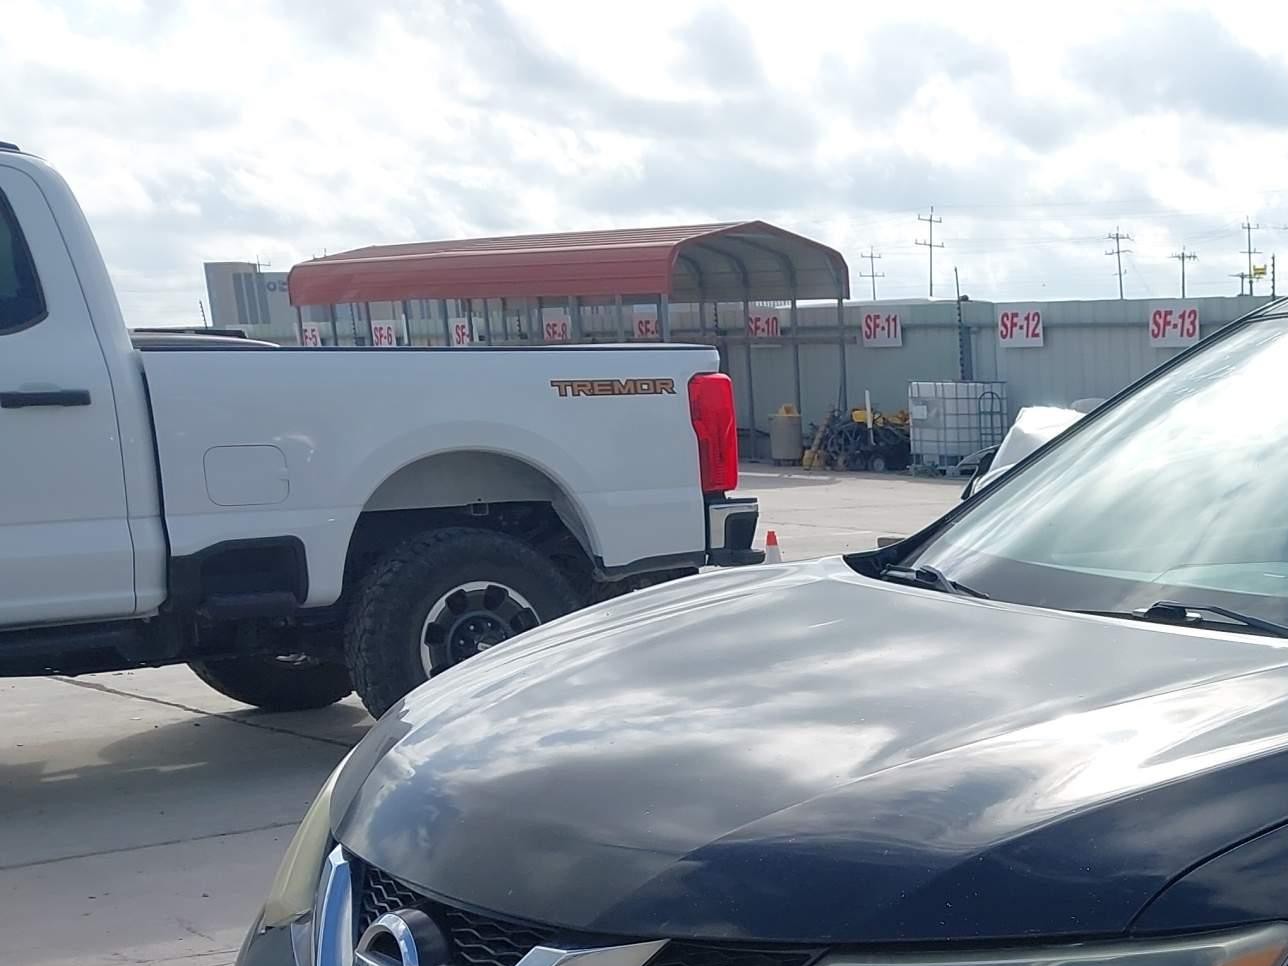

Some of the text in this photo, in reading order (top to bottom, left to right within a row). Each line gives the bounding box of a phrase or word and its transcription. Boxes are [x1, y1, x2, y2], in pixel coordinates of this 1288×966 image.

[863, 313, 899, 340] SF-11
[999, 311, 1041, 340] SF-12
[1150, 308, 1198, 339] SF-13
[303, 328, 318, 346] F-5
[373, 326, 394, 346] SF-6
[455, 324, 470, 345] SF-
[551, 378, 677, 397] TREMOR
